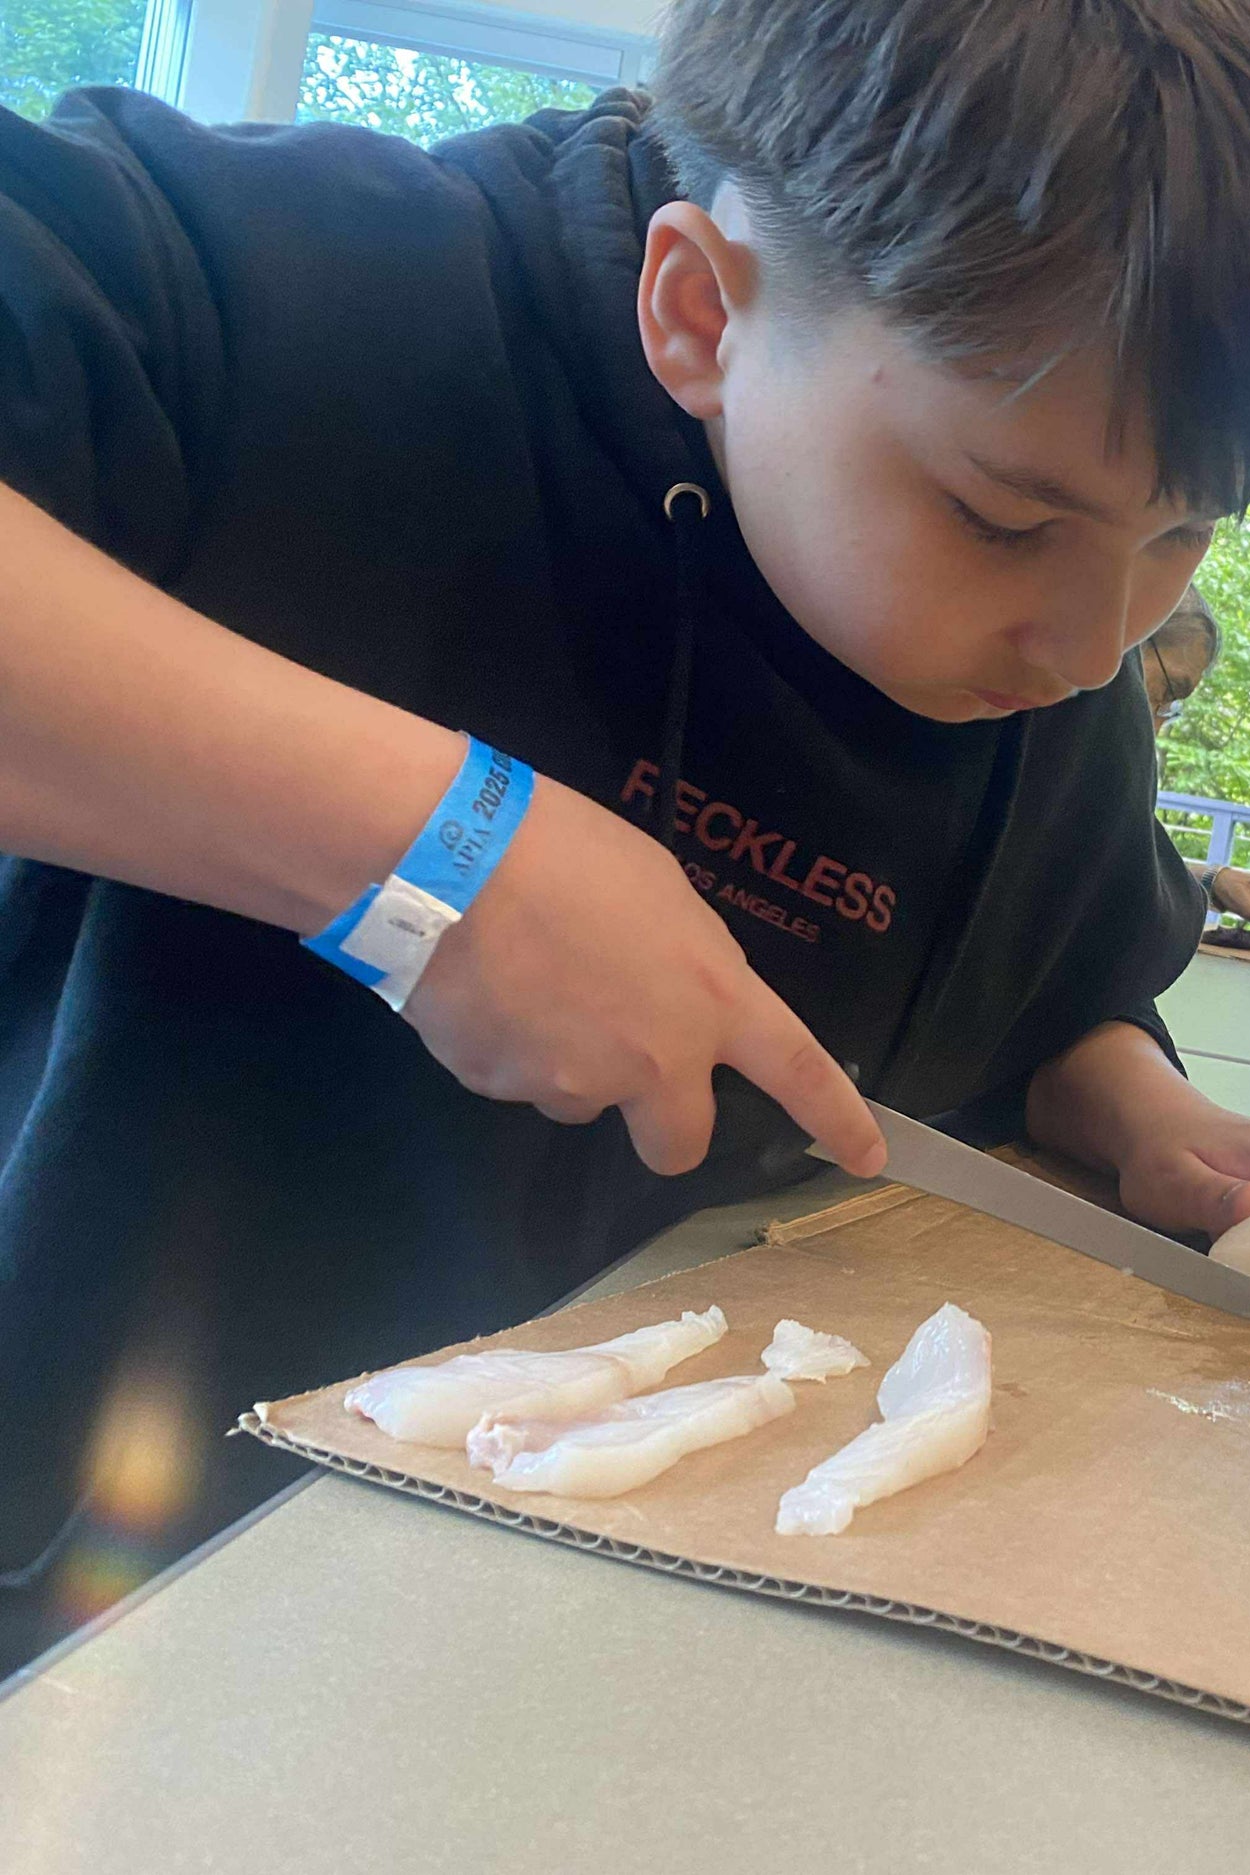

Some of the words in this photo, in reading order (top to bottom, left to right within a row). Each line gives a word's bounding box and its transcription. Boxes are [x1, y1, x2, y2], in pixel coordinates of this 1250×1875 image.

[473, 767, 511, 821] 2025
[682, 861, 717, 891] OS
[717, 883, 821, 943] ANGELES
